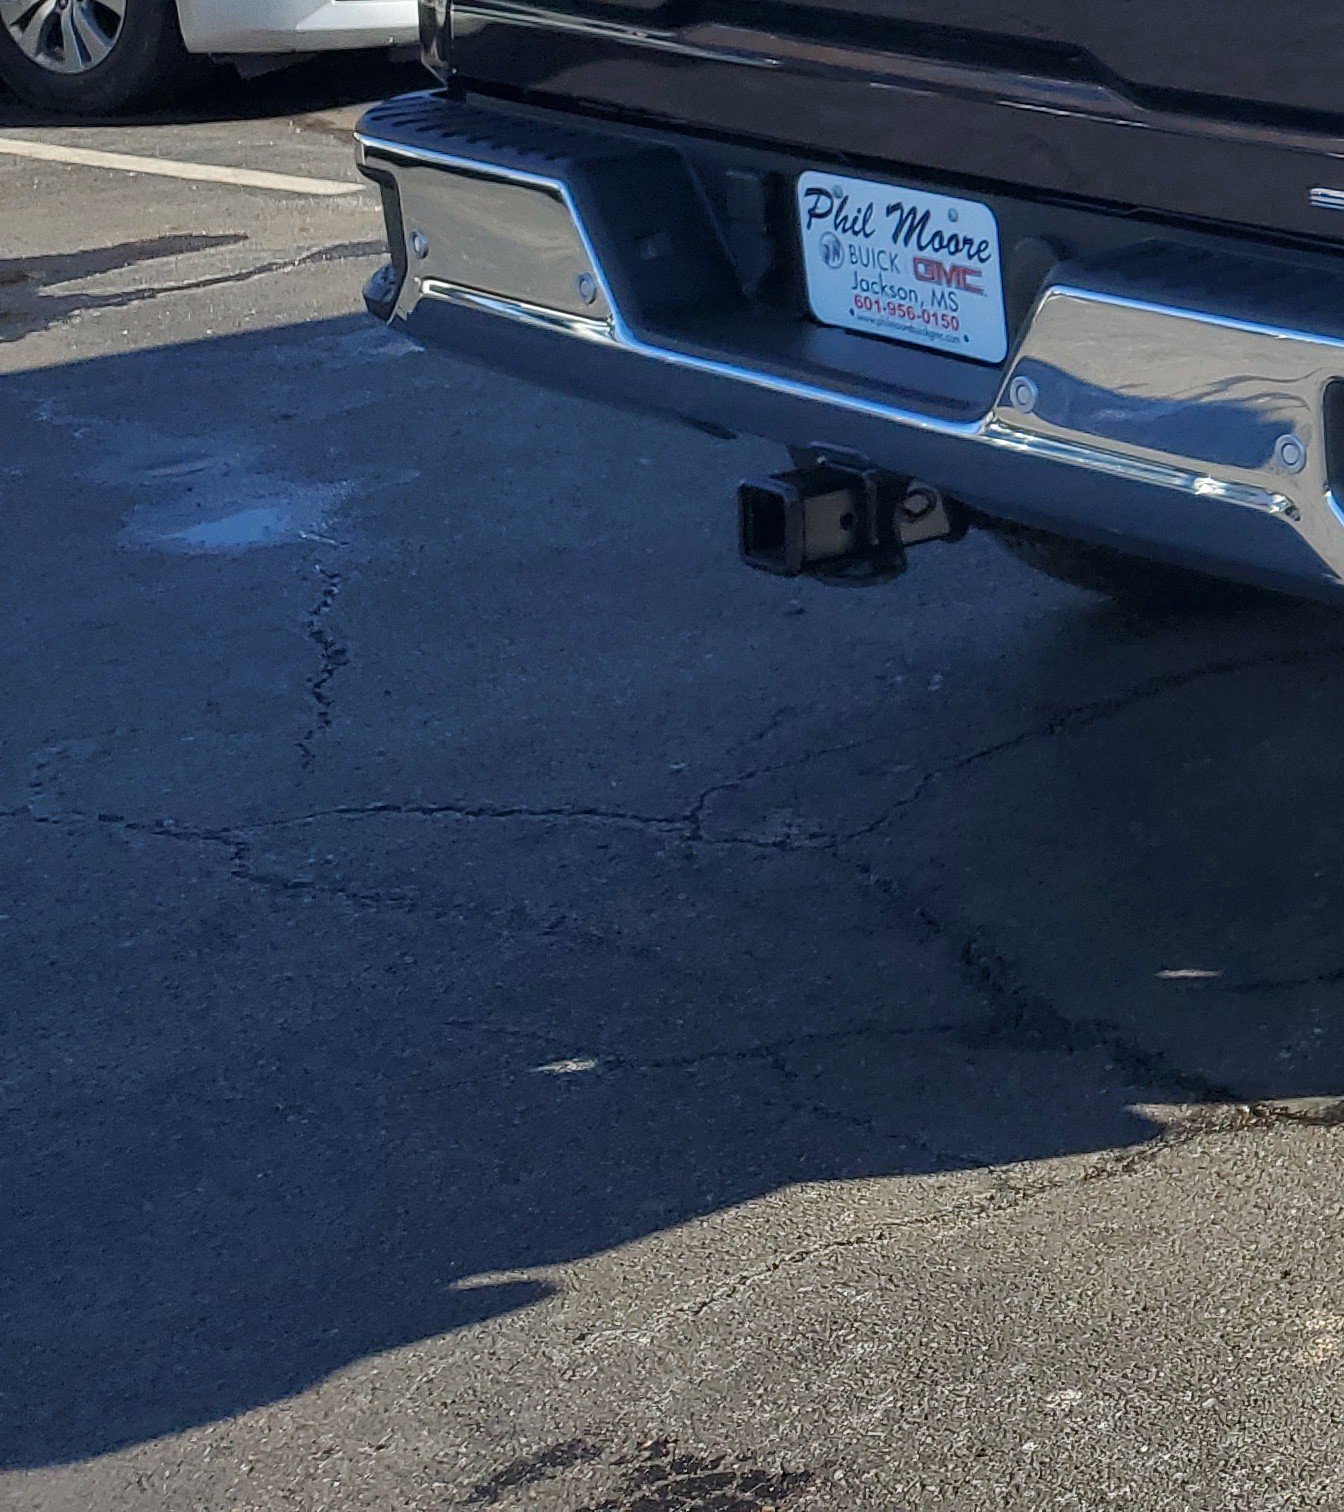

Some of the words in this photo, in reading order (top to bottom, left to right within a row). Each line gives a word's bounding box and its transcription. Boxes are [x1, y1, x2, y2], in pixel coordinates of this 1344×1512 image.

[804, 187, 876, 238] Phil
[886, 202, 992, 263] Moore
[849, 244, 901, 273] BUICK
[913, 256, 985, 294] GMC
[851, 271, 925, 309] Jackson,
[931, 288, 959, 313] MS
[854, 294, 960, 332] 601-956-0150
